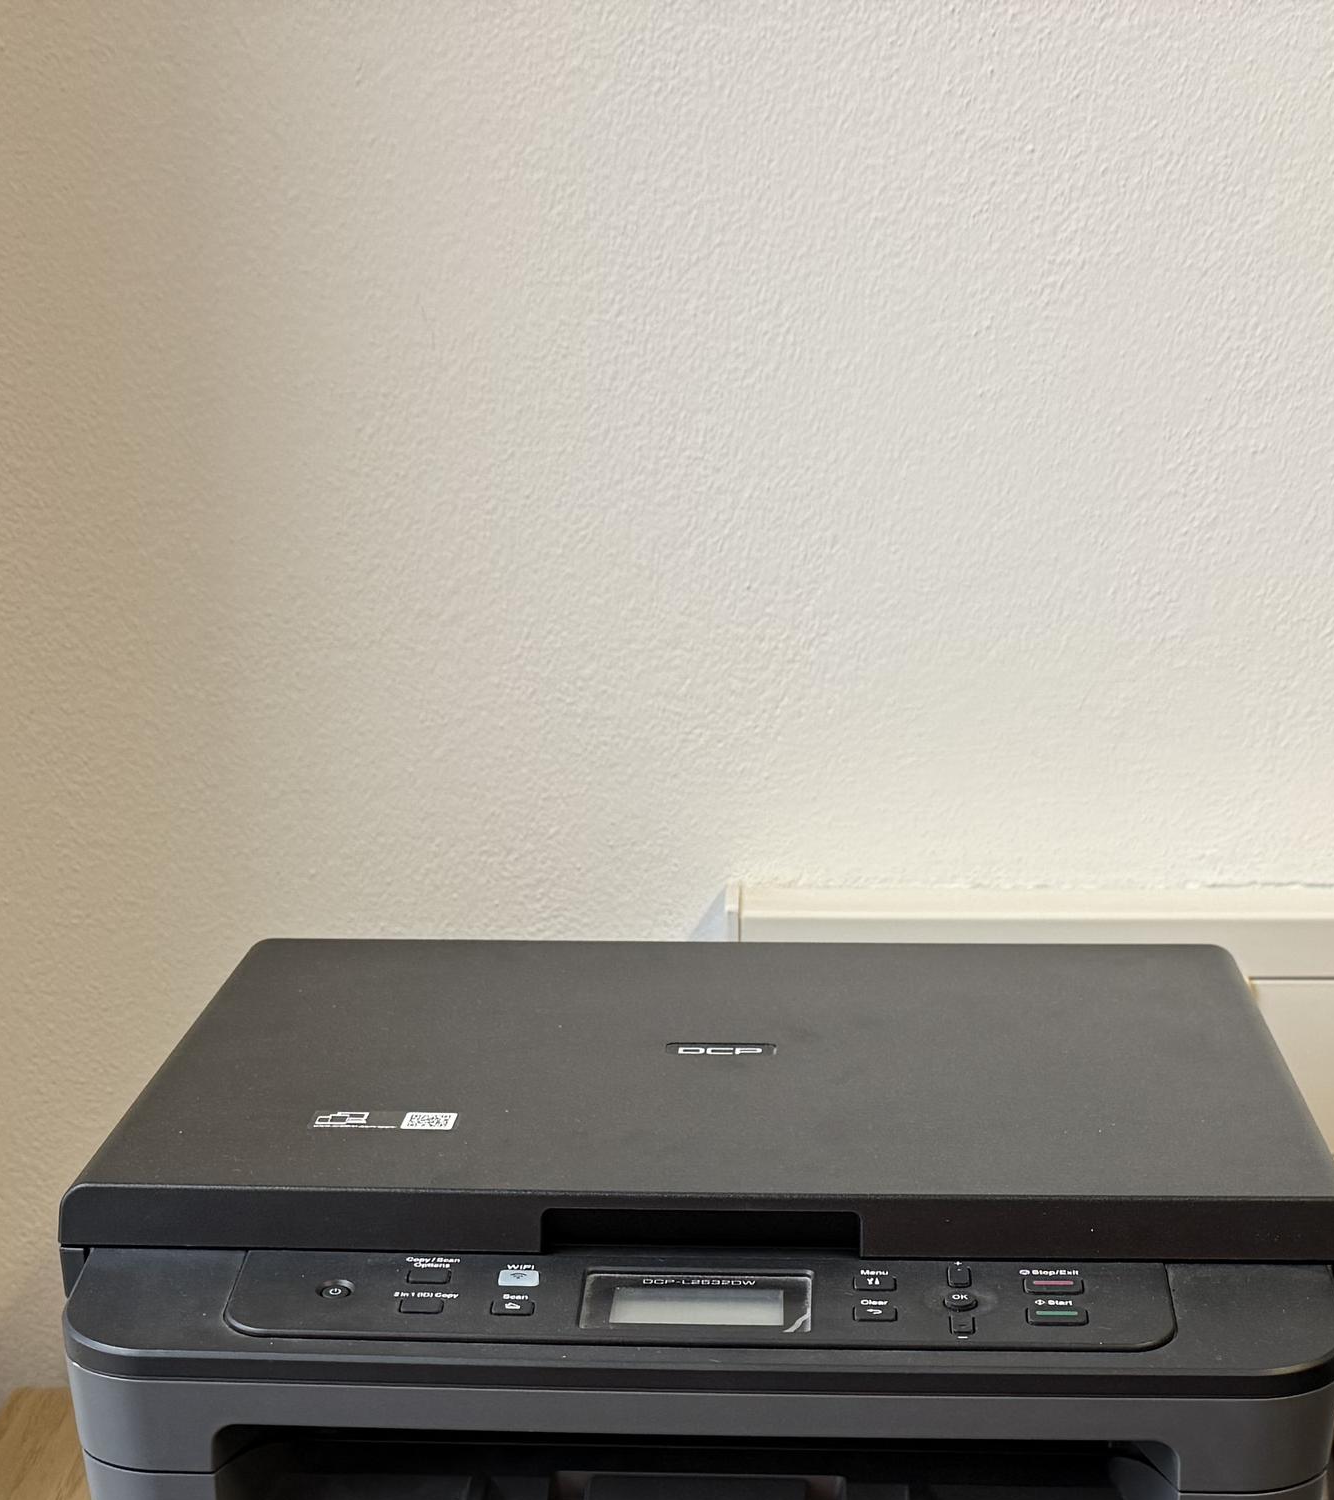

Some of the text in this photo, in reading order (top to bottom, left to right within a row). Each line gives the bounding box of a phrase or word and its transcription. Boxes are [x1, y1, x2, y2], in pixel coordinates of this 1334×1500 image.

[677, 1046, 763, 1055] DCP
[1031, 1269, 1079, 1277] Stop/Exit
[642, 1278, 756, 1286] DCP-L2532DW
